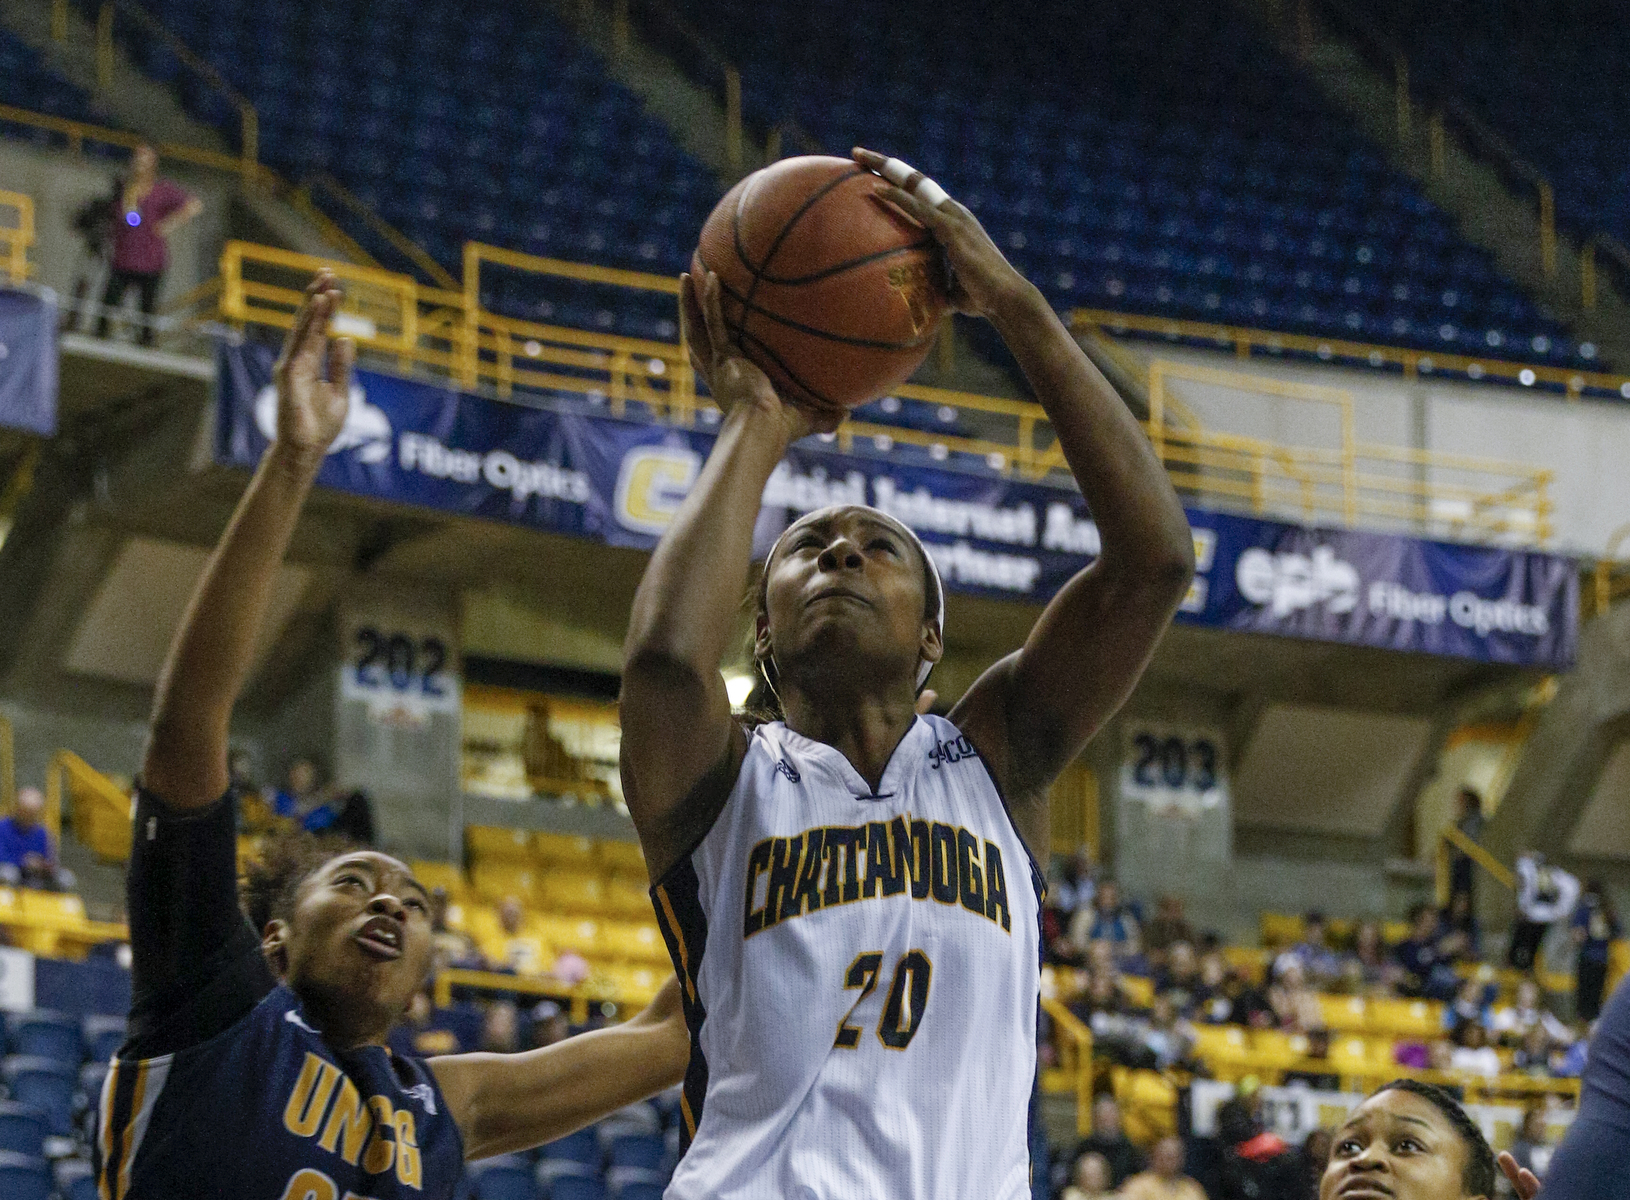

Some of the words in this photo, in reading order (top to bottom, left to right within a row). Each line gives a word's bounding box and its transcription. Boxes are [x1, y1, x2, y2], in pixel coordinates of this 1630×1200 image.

[401, 431, 483, 484] Fiber
[482, 448, 591, 502] Optics
[1368, 581, 1446, 626] Fiber
[1448, 590, 1550, 638] Optics
[357, 627, 446, 698] 202
[833, 948, 933, 1051] 20
[283, 1051, 423, 1191] UNCG
